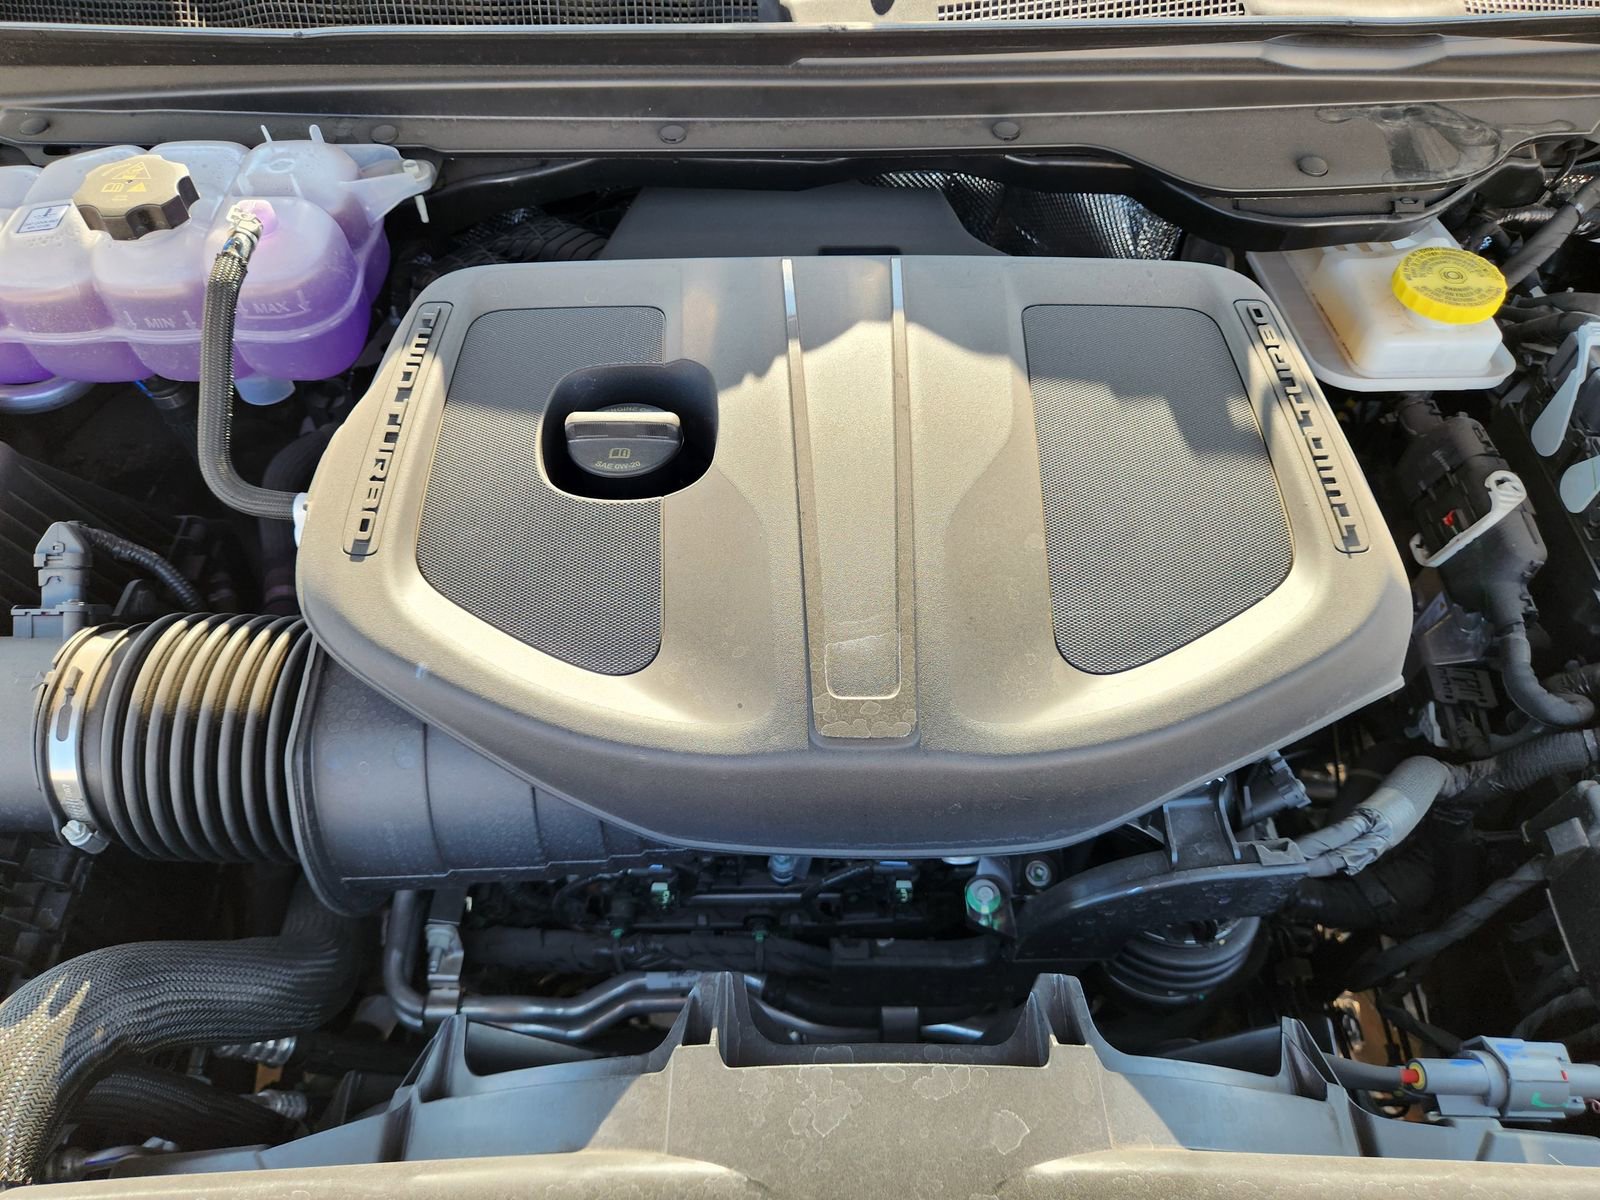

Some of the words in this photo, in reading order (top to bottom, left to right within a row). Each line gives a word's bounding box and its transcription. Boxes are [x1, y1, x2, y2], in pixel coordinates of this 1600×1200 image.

[144, 317, 176, 329] MIN
[253, 301, 291, 314] MAX
[398, 306, 441, 388] TWIN
[1246, 303, 1311, 420] TURBO
[354, 399, 409, 541] TURBO
[595, 461, 614, 470] SAE
